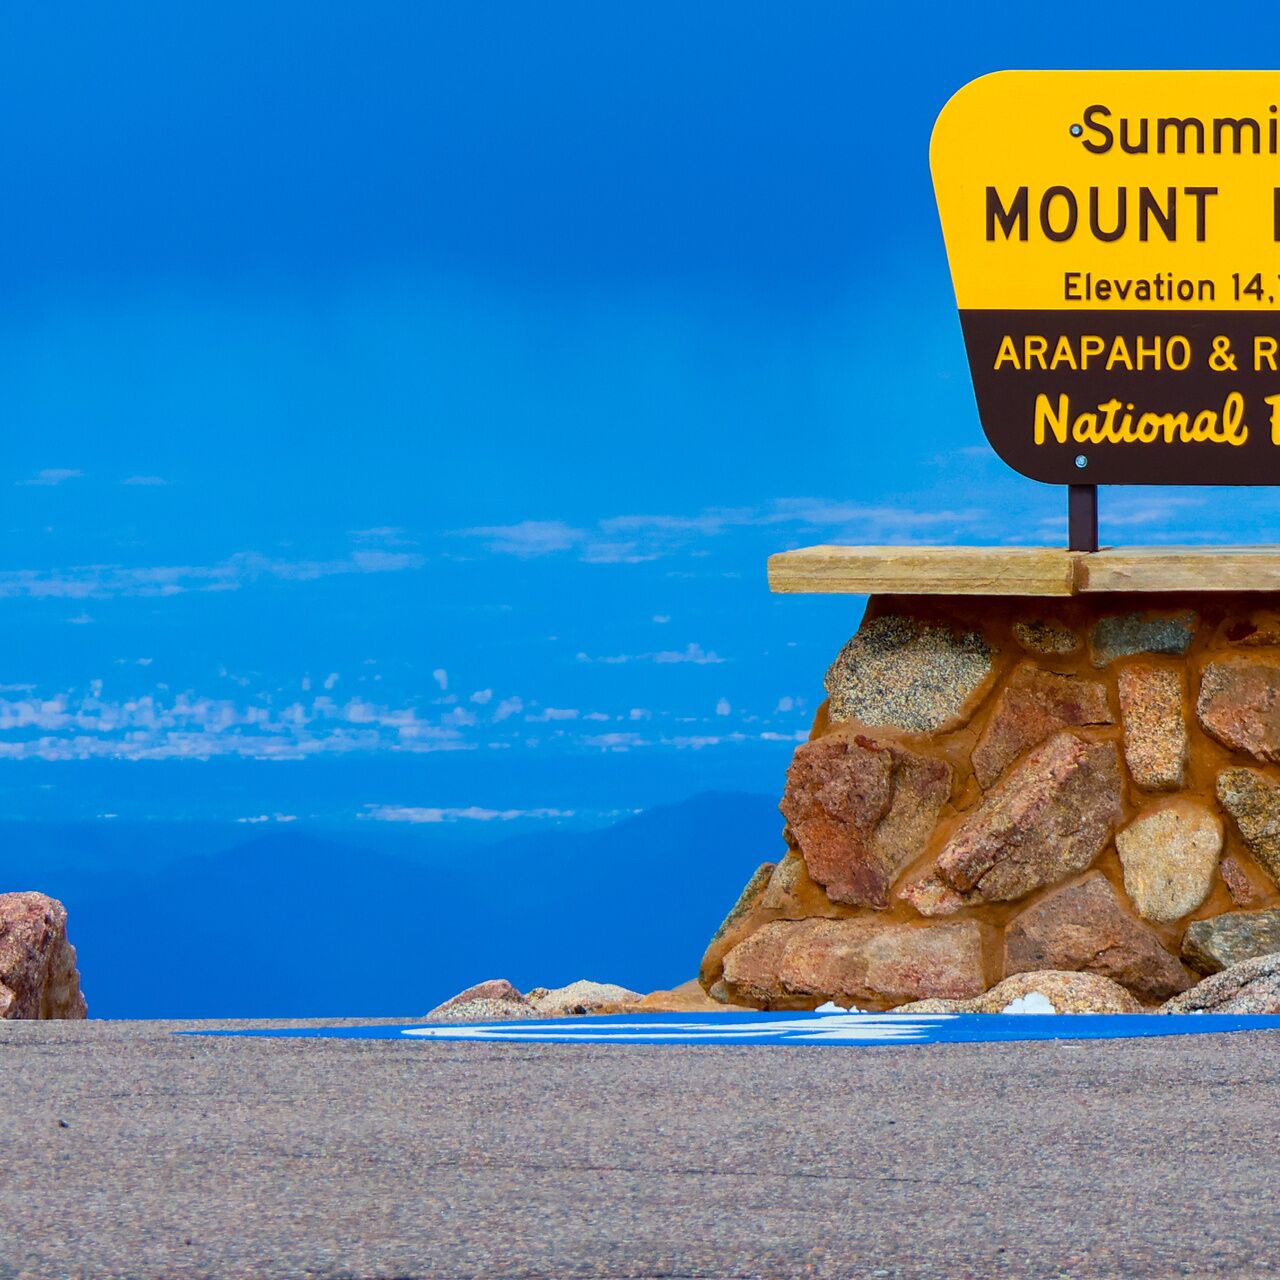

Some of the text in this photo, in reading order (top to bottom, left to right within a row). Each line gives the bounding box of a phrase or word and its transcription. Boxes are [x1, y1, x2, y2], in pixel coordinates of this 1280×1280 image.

[986, 186, 1217, 242] MOUNT
[1065, 273, 1214, 300] Elevation
[994, 336, 1190, 370] ARAPAHO
[1209, 336, 1237, 371] &
[1035, 392, 1248, 445] National
